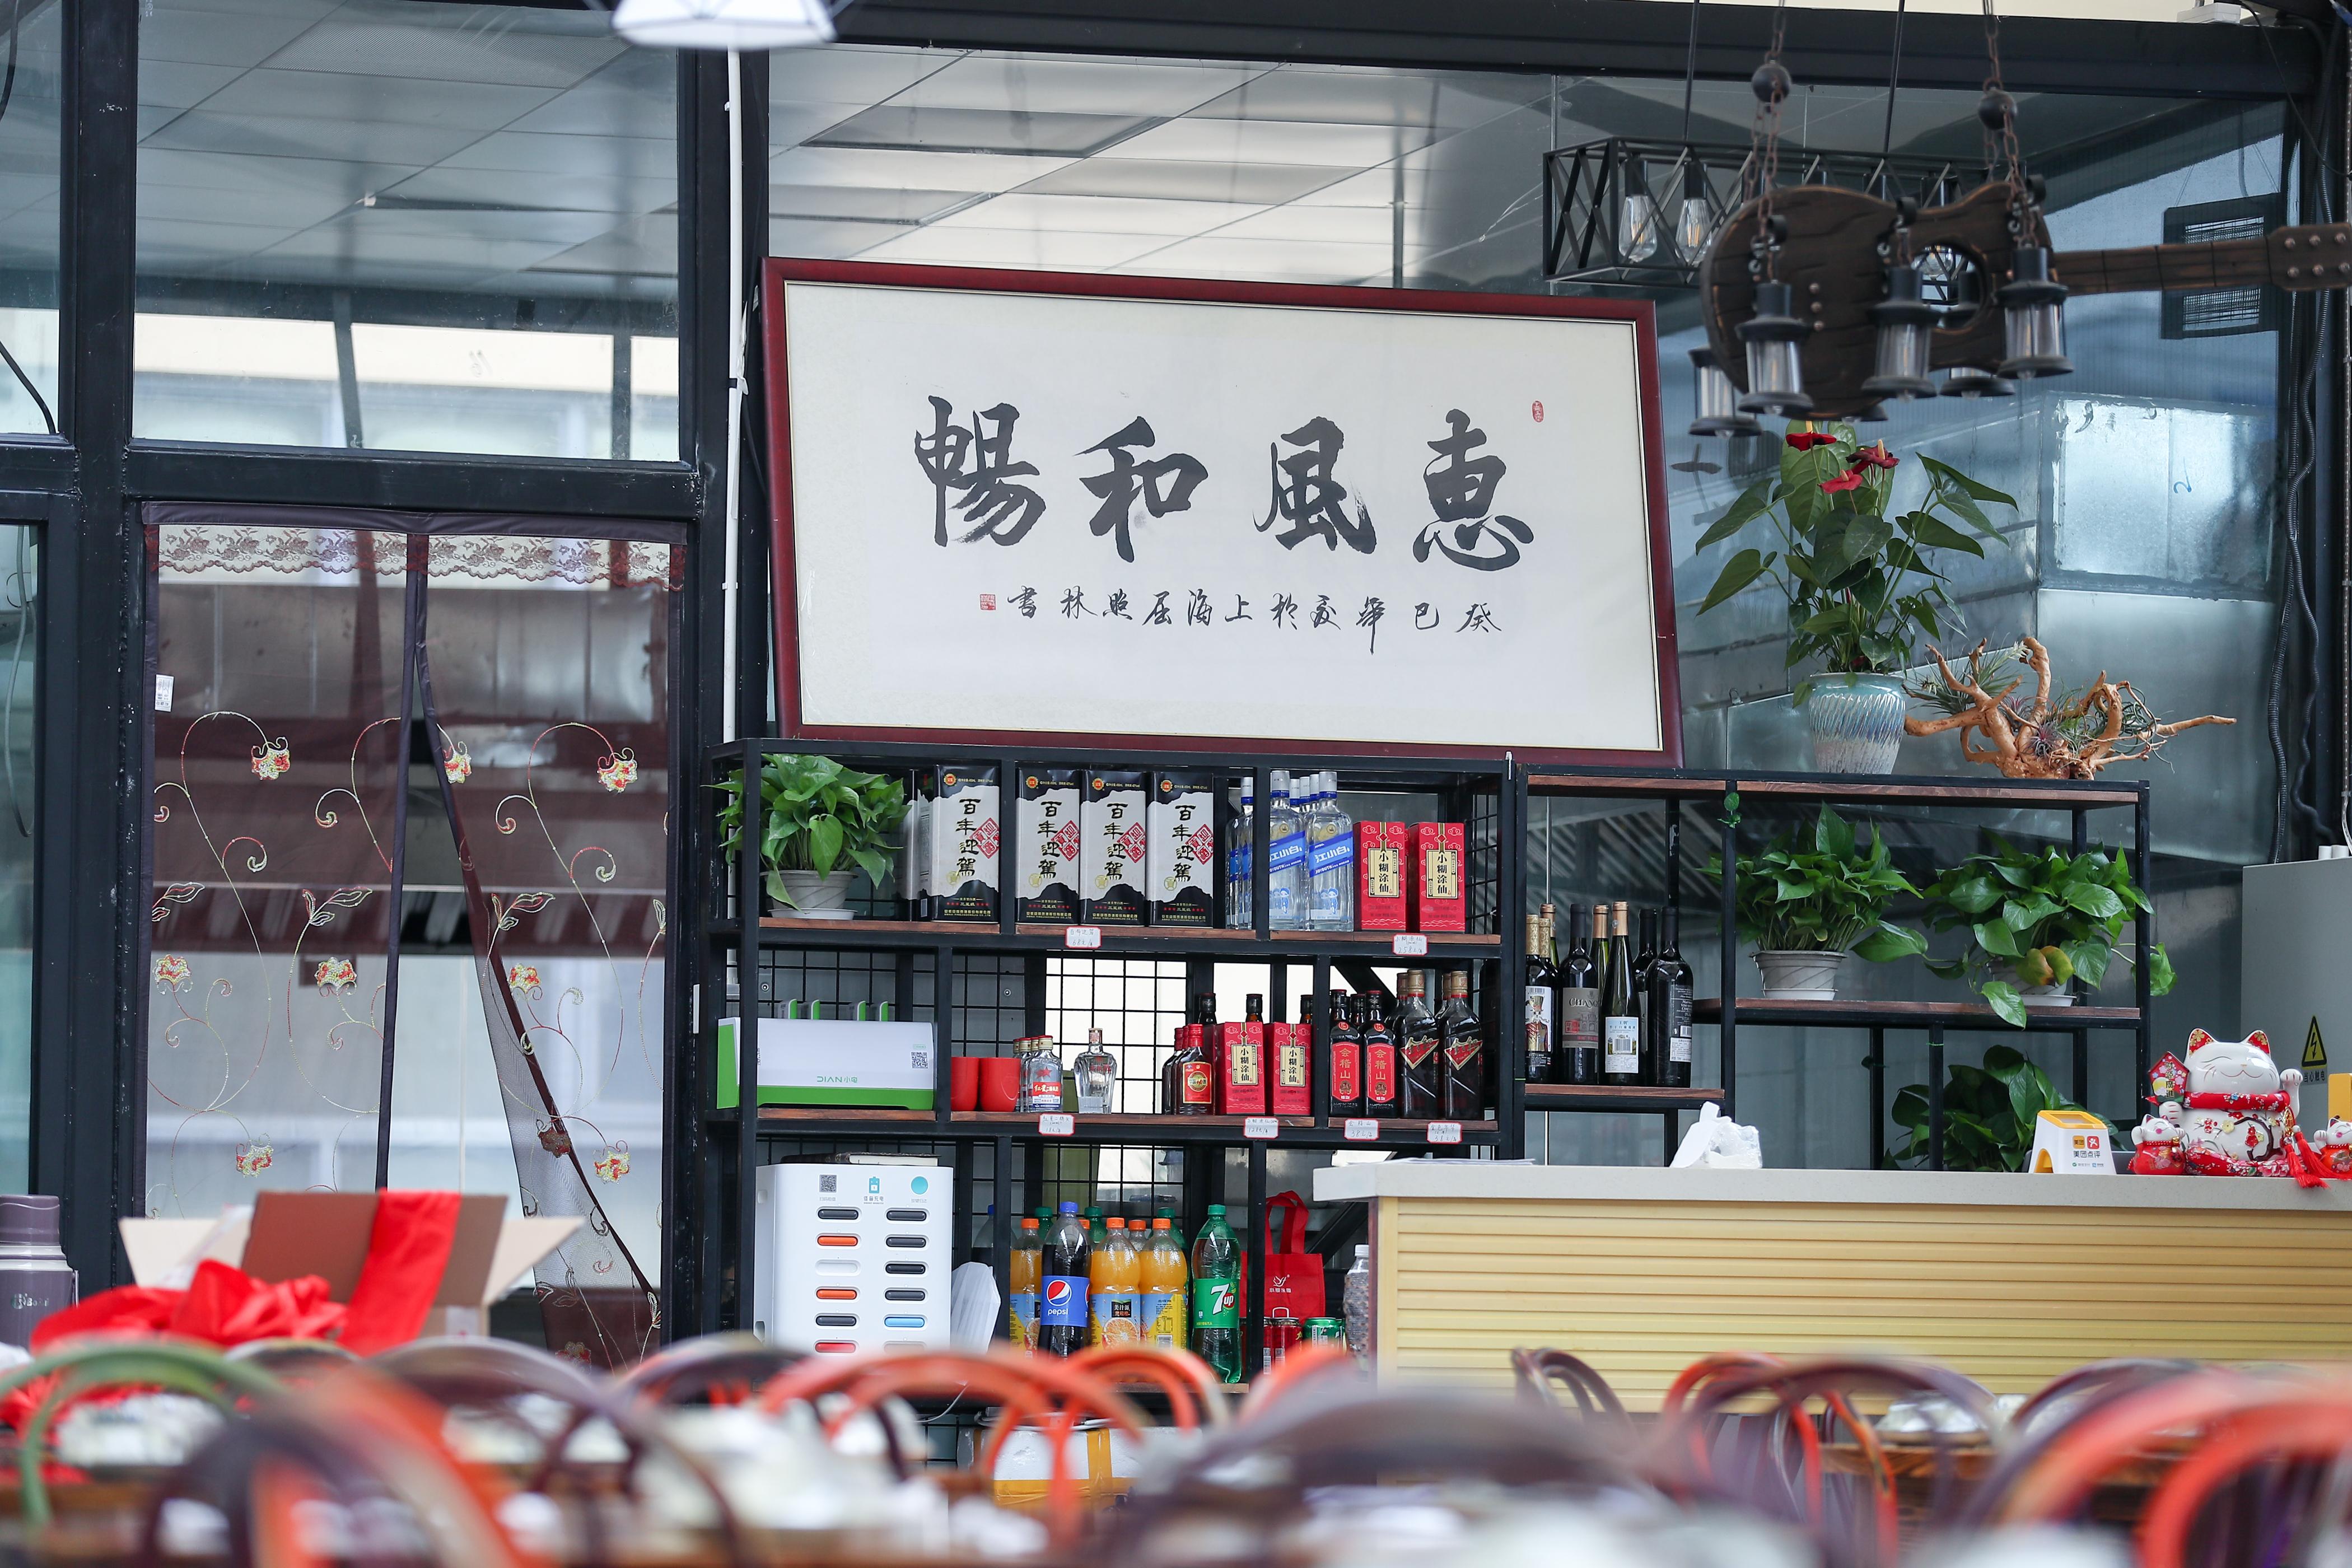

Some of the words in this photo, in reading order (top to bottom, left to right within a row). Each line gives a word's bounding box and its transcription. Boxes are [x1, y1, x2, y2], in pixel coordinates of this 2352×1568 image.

[1269, 864, 1285, 872] OYOUTH
[1314, 846, 1350, 863] 江小白
[1379, 853, 1389, 893] 小糊涂仙
[1437, 854, 1448, 894] 小糊涂仙
[1569, 997, 1599, 1009] CHANG
[1240, 1048, 1249, 1081] 小糊涂仙
[1289, 1049, 1297, 1082] 小糊涂仙
[1340, 1048, 1352, 1079] 会稽山
[1374, 1049, 1387, 1080] 会稽山
[2303, 1071, 2325, 1083] 当心触电
[1047, 1308, 1068, 1316] pepsi
